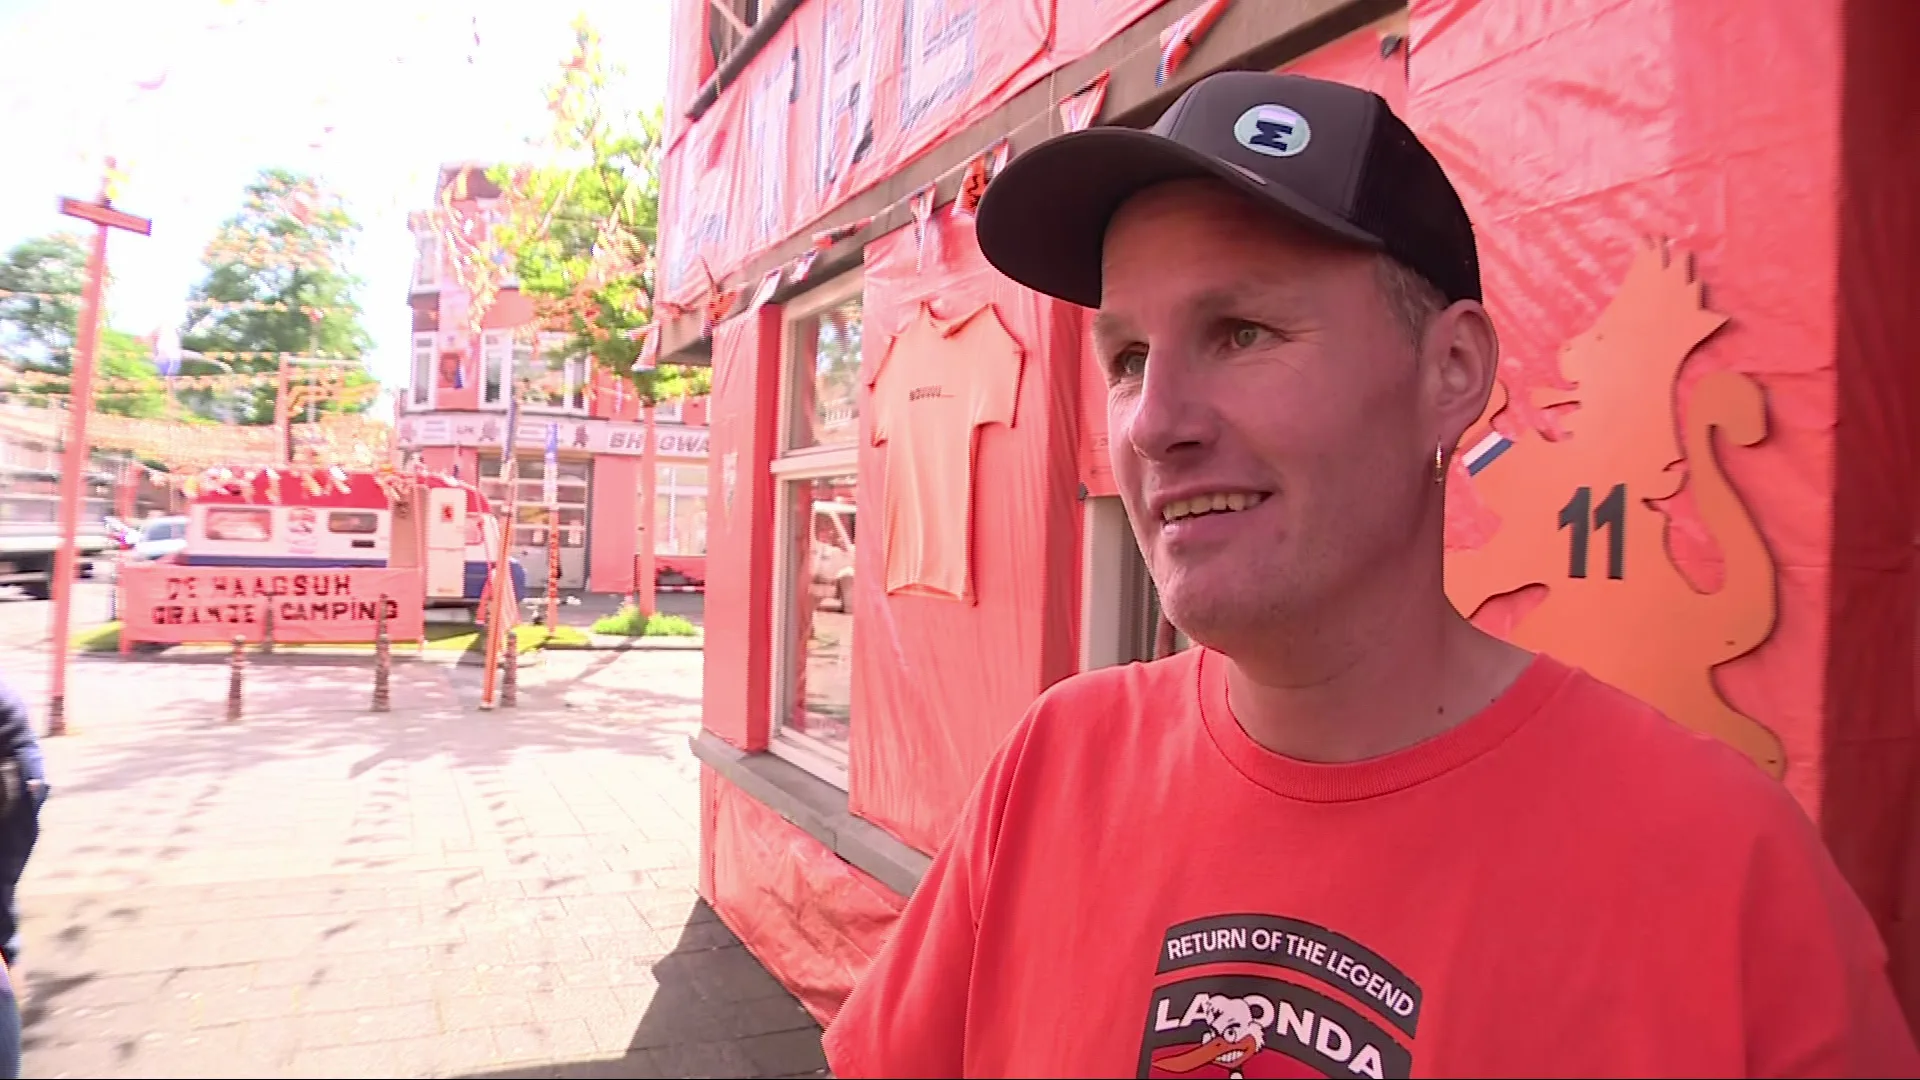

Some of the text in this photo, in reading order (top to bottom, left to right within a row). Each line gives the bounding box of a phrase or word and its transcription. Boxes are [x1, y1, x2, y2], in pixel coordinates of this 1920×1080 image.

[1558, 483, 1626, 580] 11
[166, 577, 198, 600] DE
[1167, 928, 1415, 1017] RETURN OF THE LEGEND
